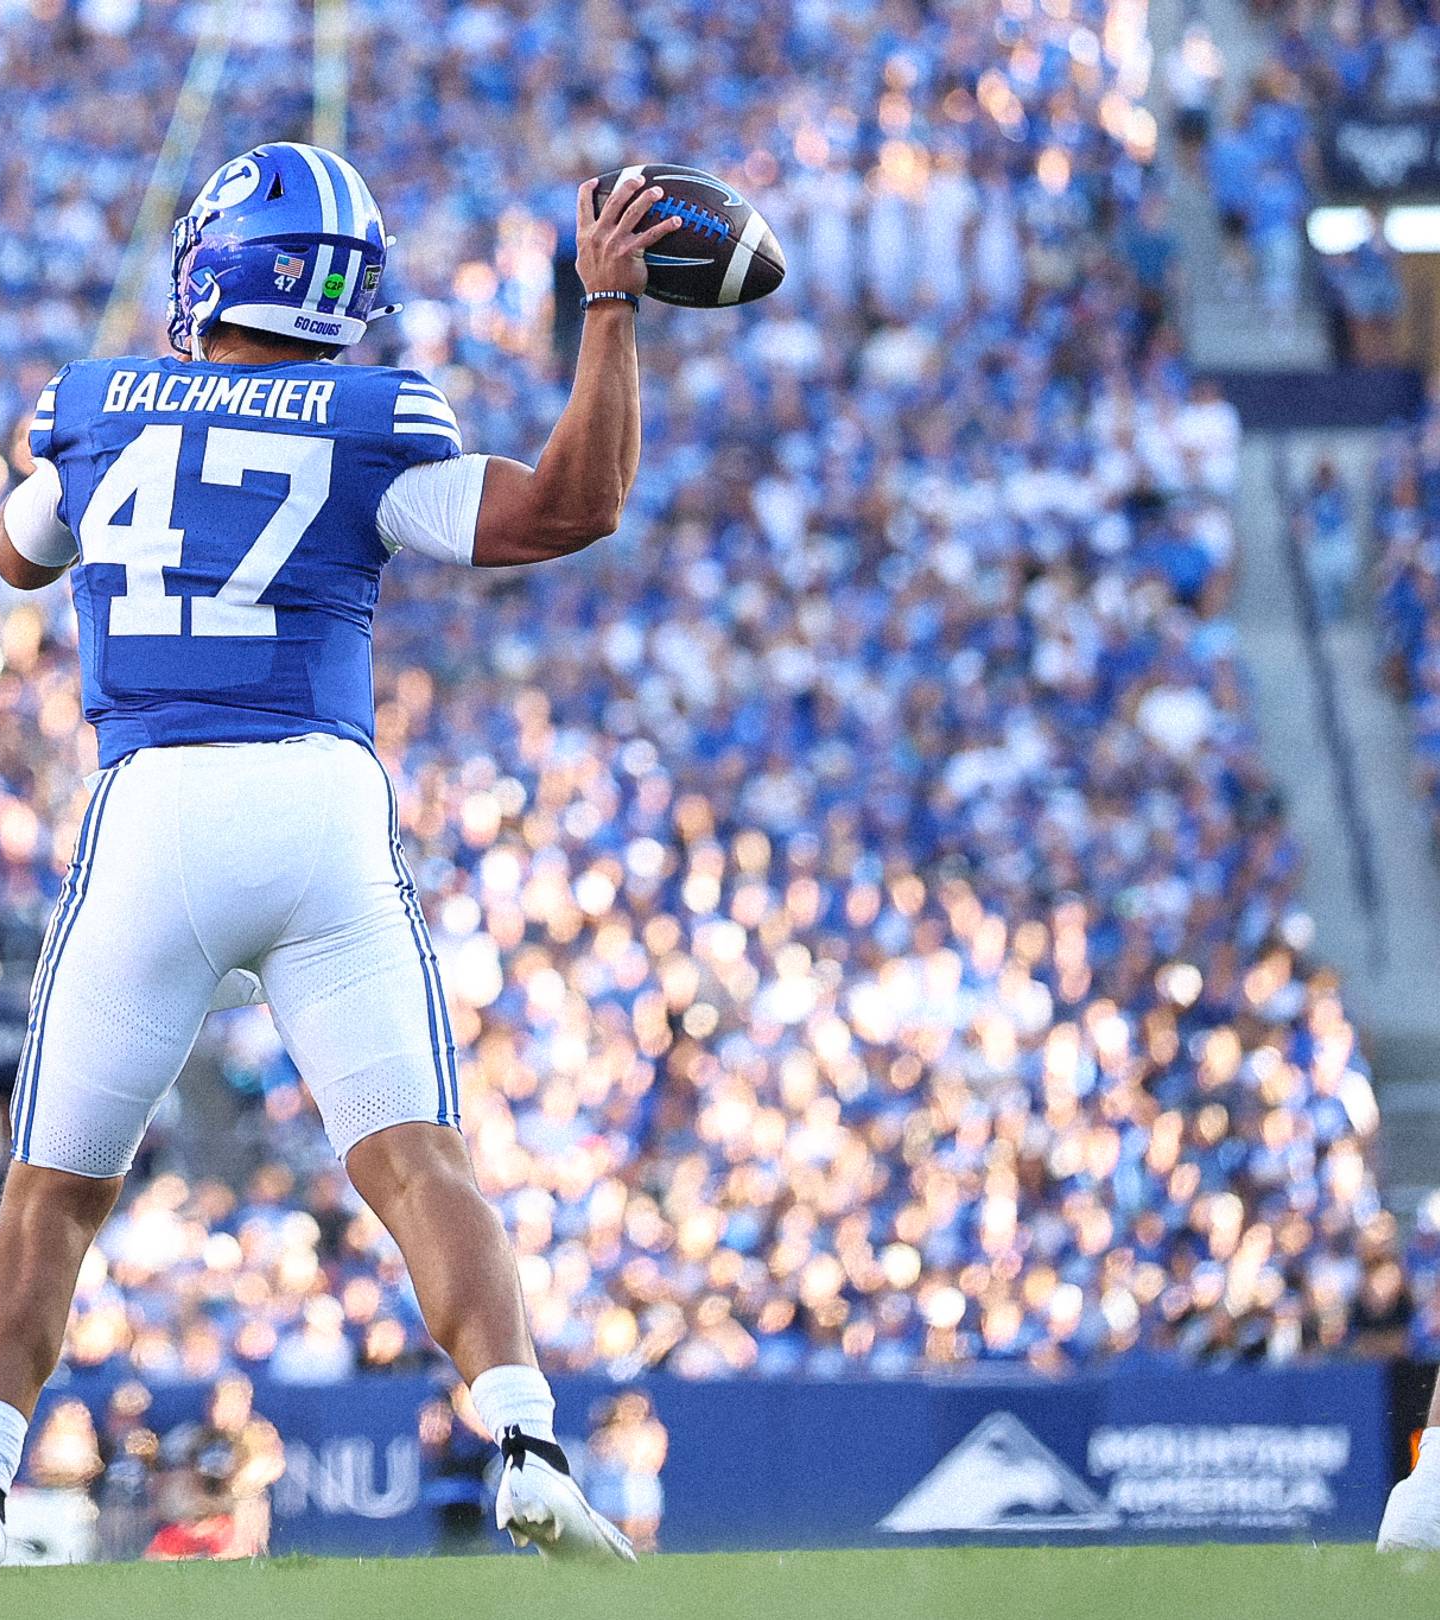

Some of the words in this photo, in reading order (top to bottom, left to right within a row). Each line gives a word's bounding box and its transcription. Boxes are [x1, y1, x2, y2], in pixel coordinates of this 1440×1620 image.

[274, 276, 296, 292] 47
[324, 280, 344, 291] C2P
[294, 315, 310, 331] GO
[308, 320, 342, 336] COUGS
[102, 370, 335, 424] BACHMEIER
[78, 423, 335, 637] 47
